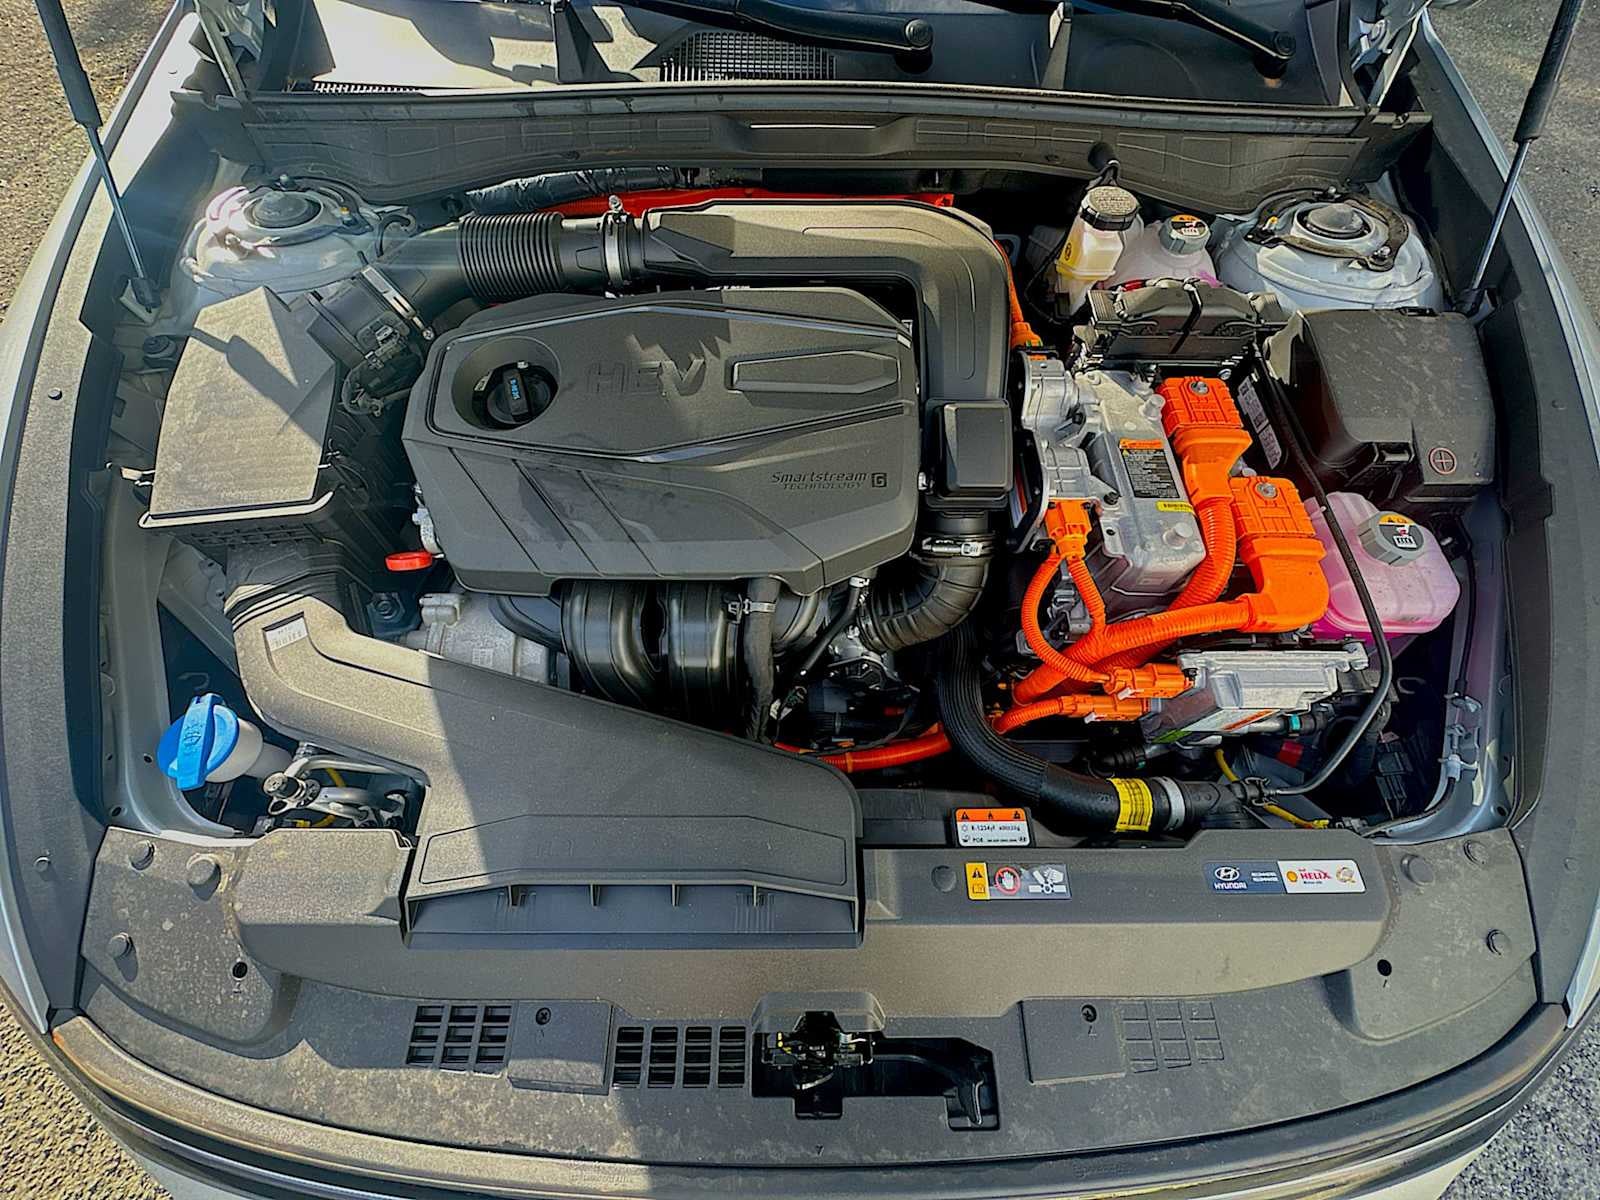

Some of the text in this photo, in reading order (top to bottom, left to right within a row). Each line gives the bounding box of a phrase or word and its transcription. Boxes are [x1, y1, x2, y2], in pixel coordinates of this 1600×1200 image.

[587, 359, 704, 396] HEV
[771, 472, 888, 488] Smartstream G
[784, 482, 862, 490] TECHNOLOGY
[1300, 872, 1332, 880] HELIX
[1214, 882, 1247, 890] HYUNDAI
